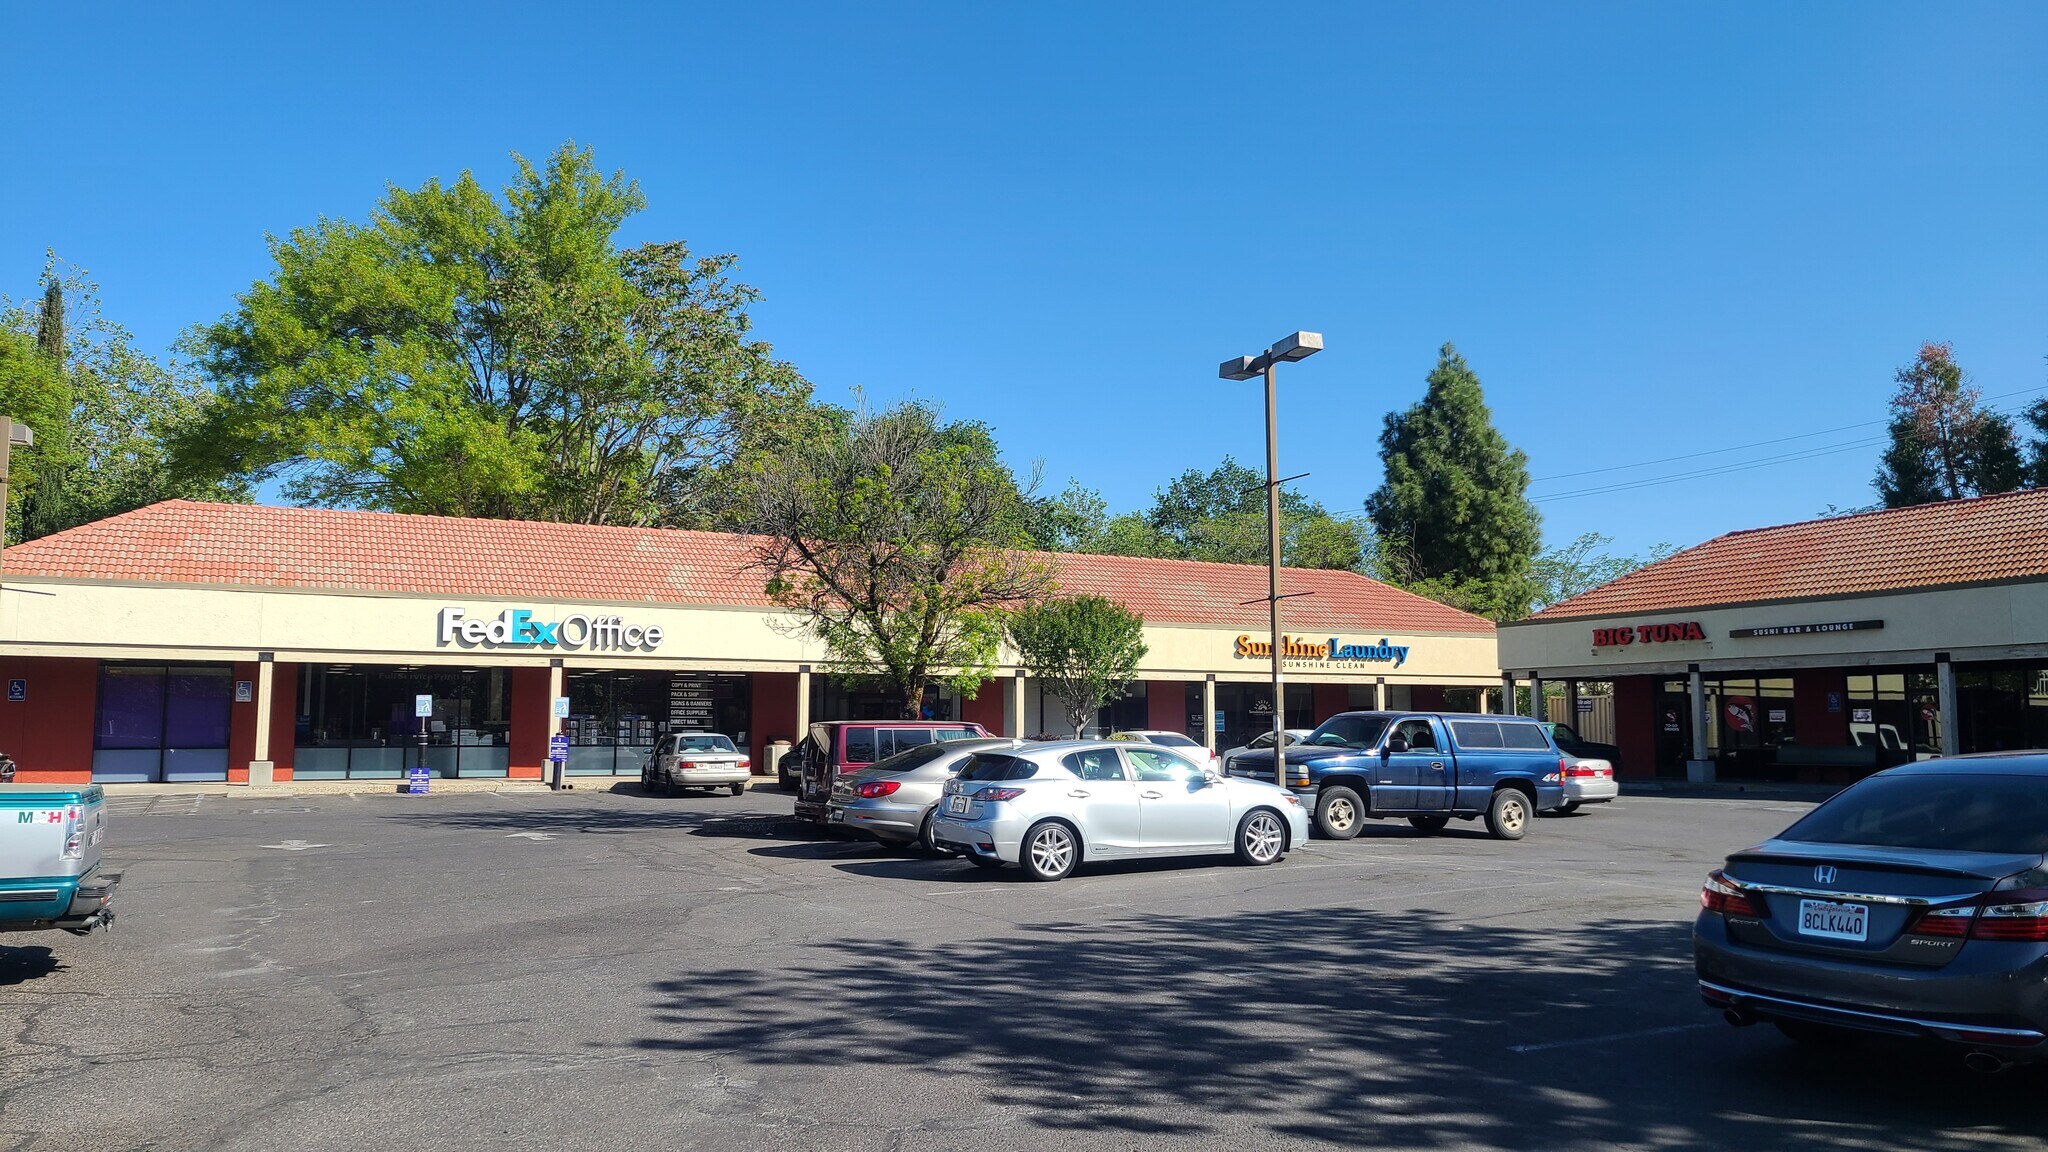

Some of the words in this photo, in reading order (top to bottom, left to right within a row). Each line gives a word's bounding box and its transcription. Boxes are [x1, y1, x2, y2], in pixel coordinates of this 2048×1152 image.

[561, 613, 665, 649] Office
[1592, 627, 1634, 646] BIG
[1637, 621, 1707, 643] TUNA
[1753, 628, 1779, 636] SUSHI
[1783, 626, 1800, 634] BAR
[1805, 625, 1811, 633] &
[1816, 623, 1854, 632] LOUNGE
[1330, 637, 1410, 665] Laundry
[1282, 661, 1331, 669] SUNSHINE
[1804, 912, 1862, 935] 8CLK440
[1910, 939, 1955, 948] SPORT
